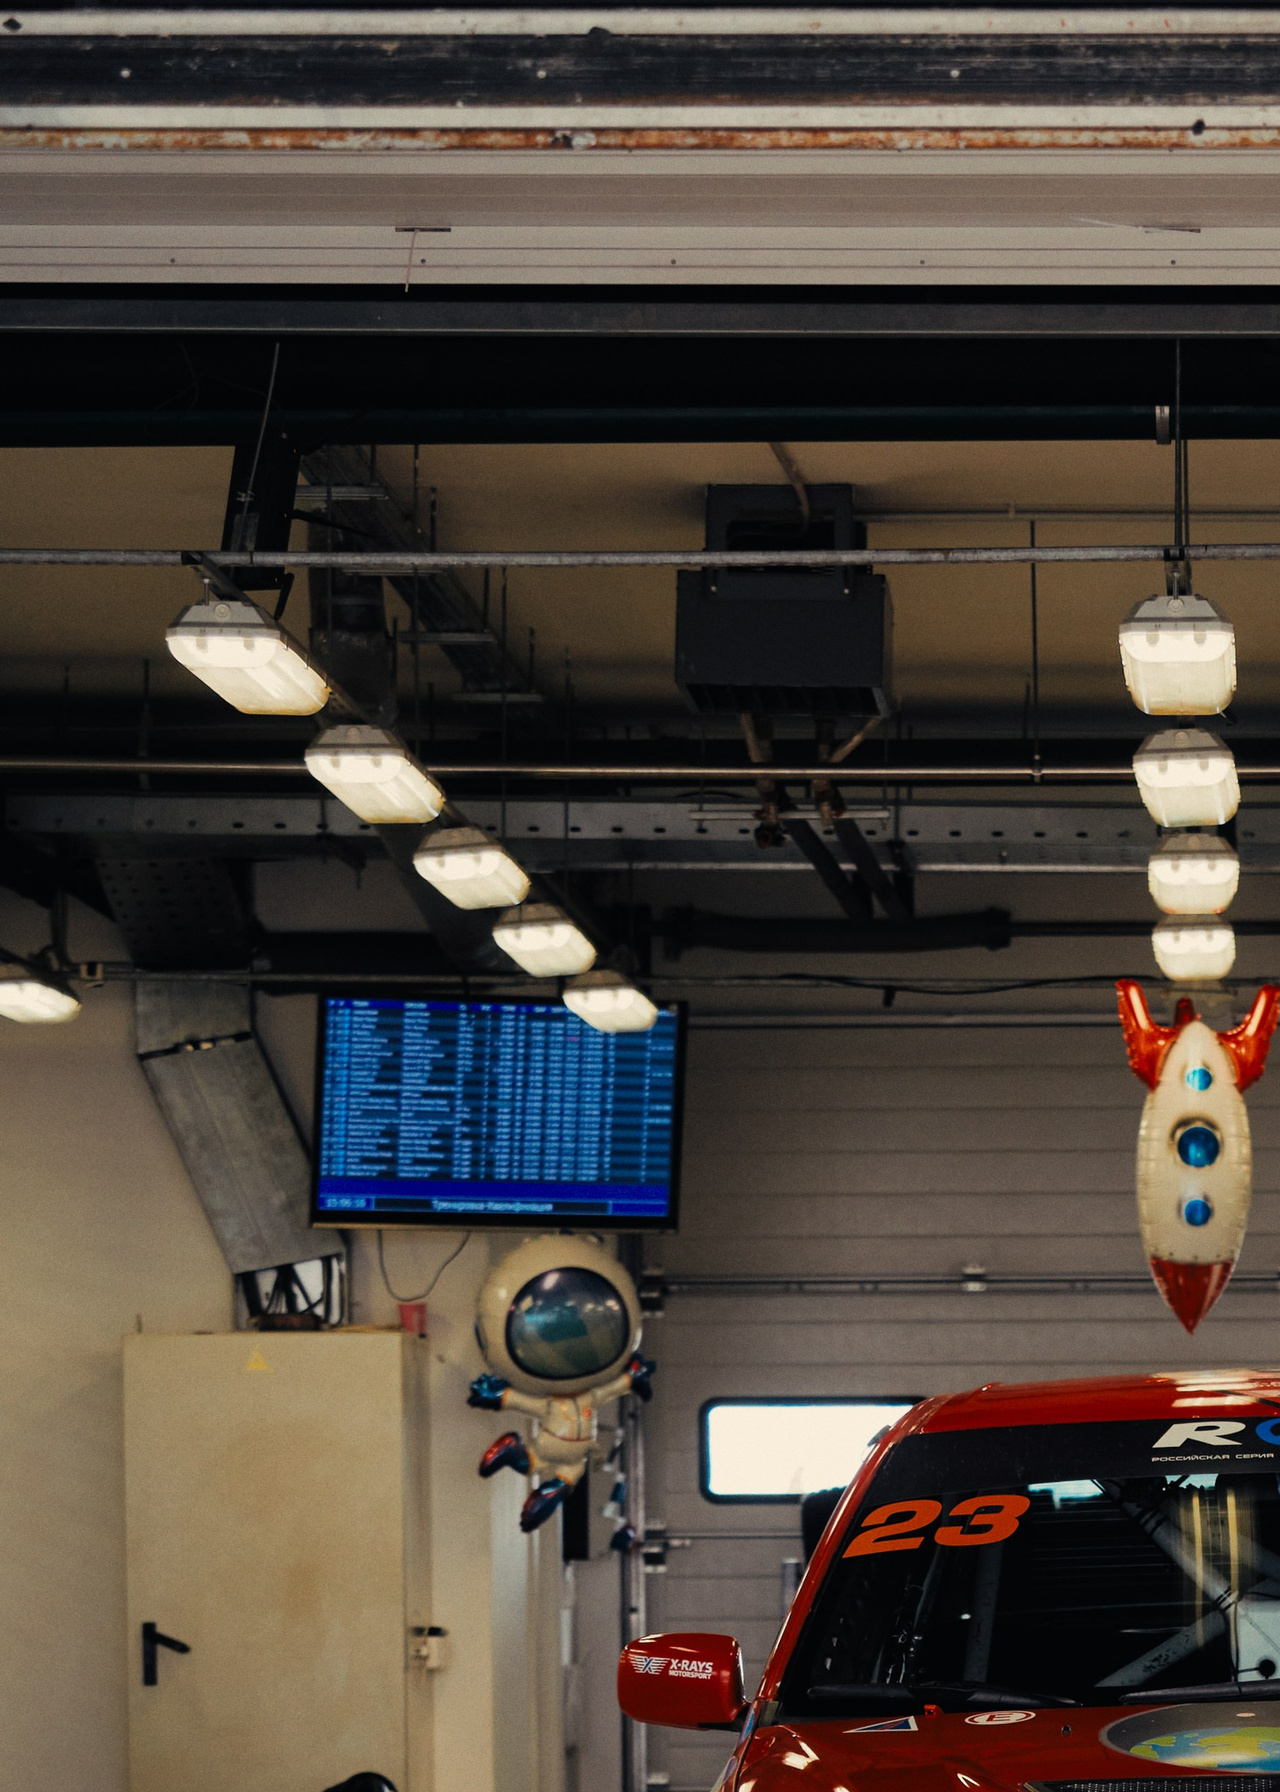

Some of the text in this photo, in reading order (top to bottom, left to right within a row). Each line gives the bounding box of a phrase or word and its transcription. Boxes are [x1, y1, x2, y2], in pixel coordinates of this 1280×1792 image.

[1152, 1453, 1231, 1463] РОССИЙСКАЯ
[1235, 1452, 1275, 1460] СЕРИЯ
[842, 1494, 1031, 1559] 23
[669, 1658, 714, 1673] X-RAYS
[668, 1669, 712, 1680] MOTORSPORT
